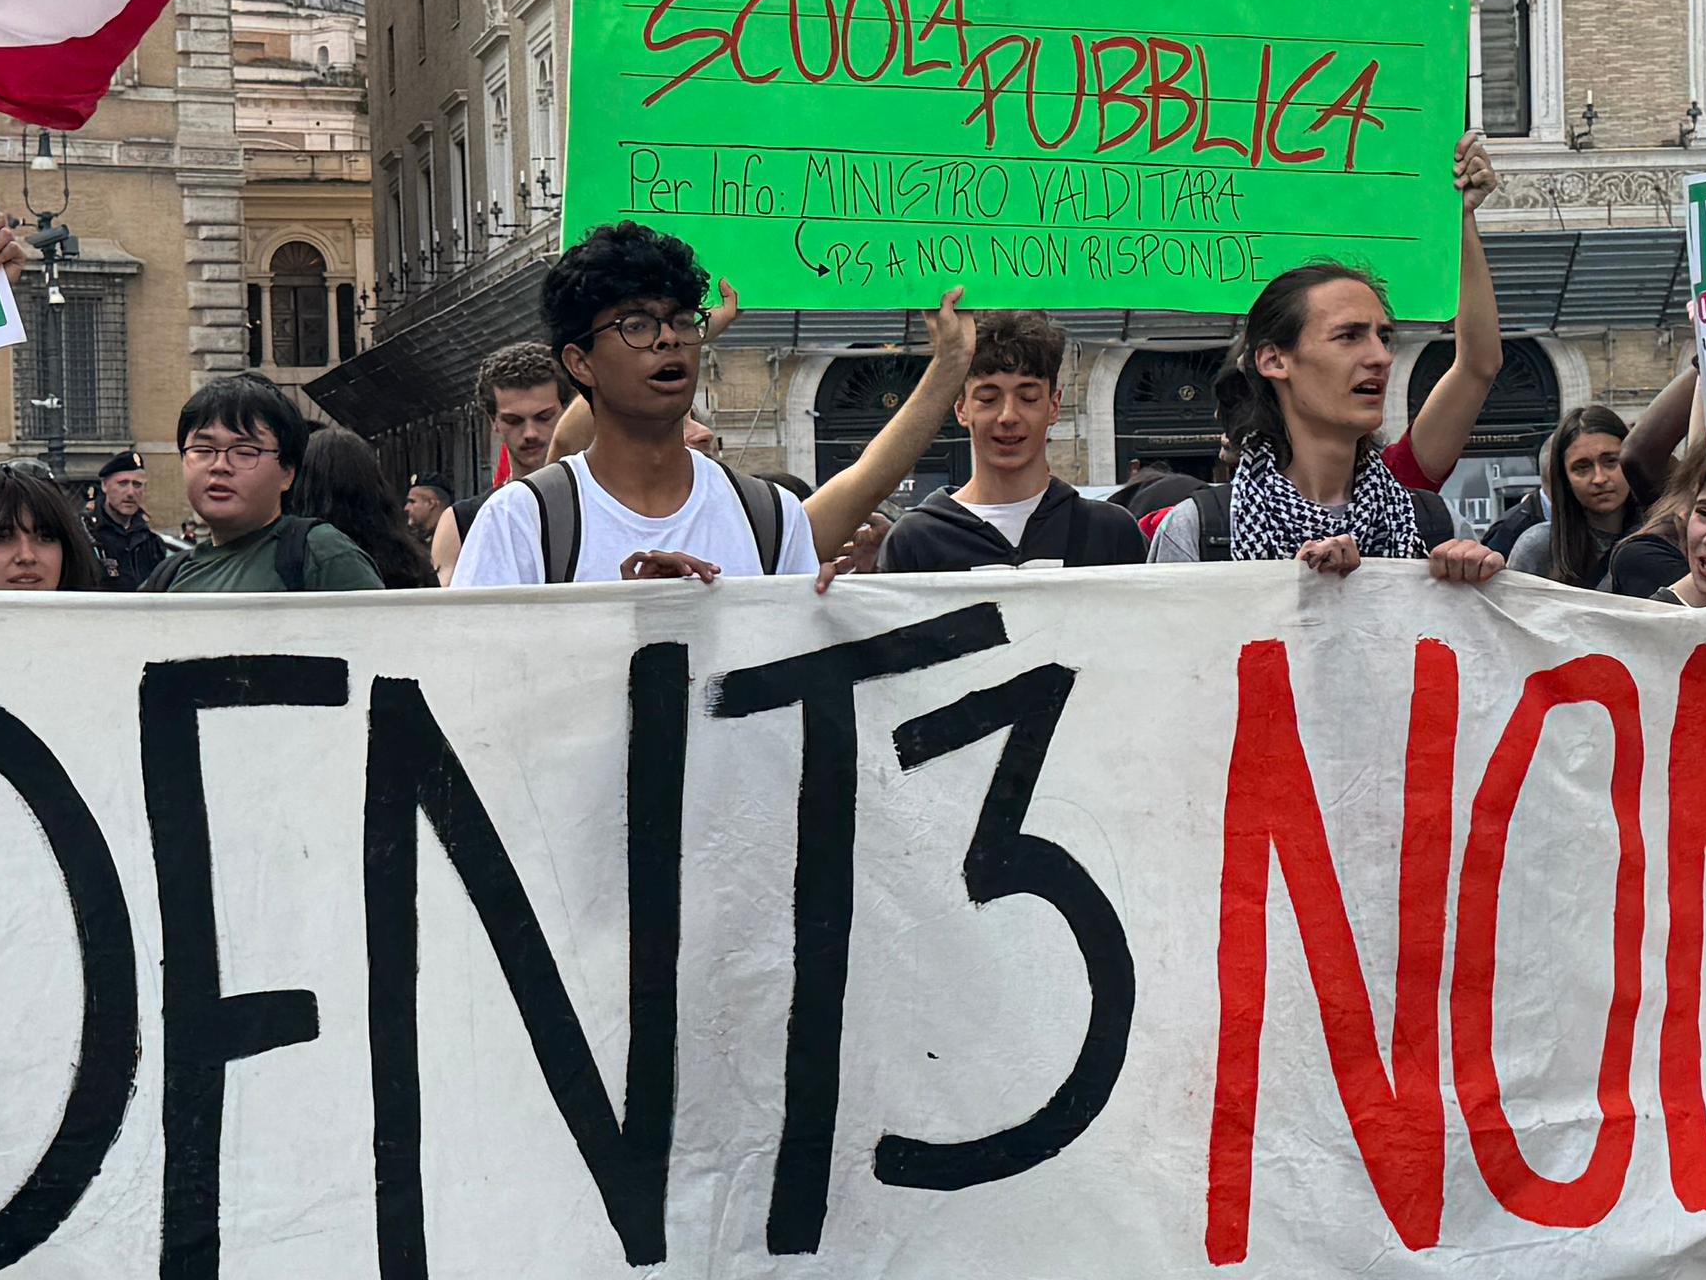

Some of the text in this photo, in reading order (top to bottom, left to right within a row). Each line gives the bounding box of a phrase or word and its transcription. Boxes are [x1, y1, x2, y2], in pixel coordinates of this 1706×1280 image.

[957, 33, 1384, 171] PUBBLICA
[628, 147, 1245, 224] Per Info: MINISTRO VALDITARA
[885, 239, 906, 272] A
[917, 233, 979, 276] NOI
[993, 234, 1069, 280] NON
[1087, 234, 1270, 285] RISPONDE
